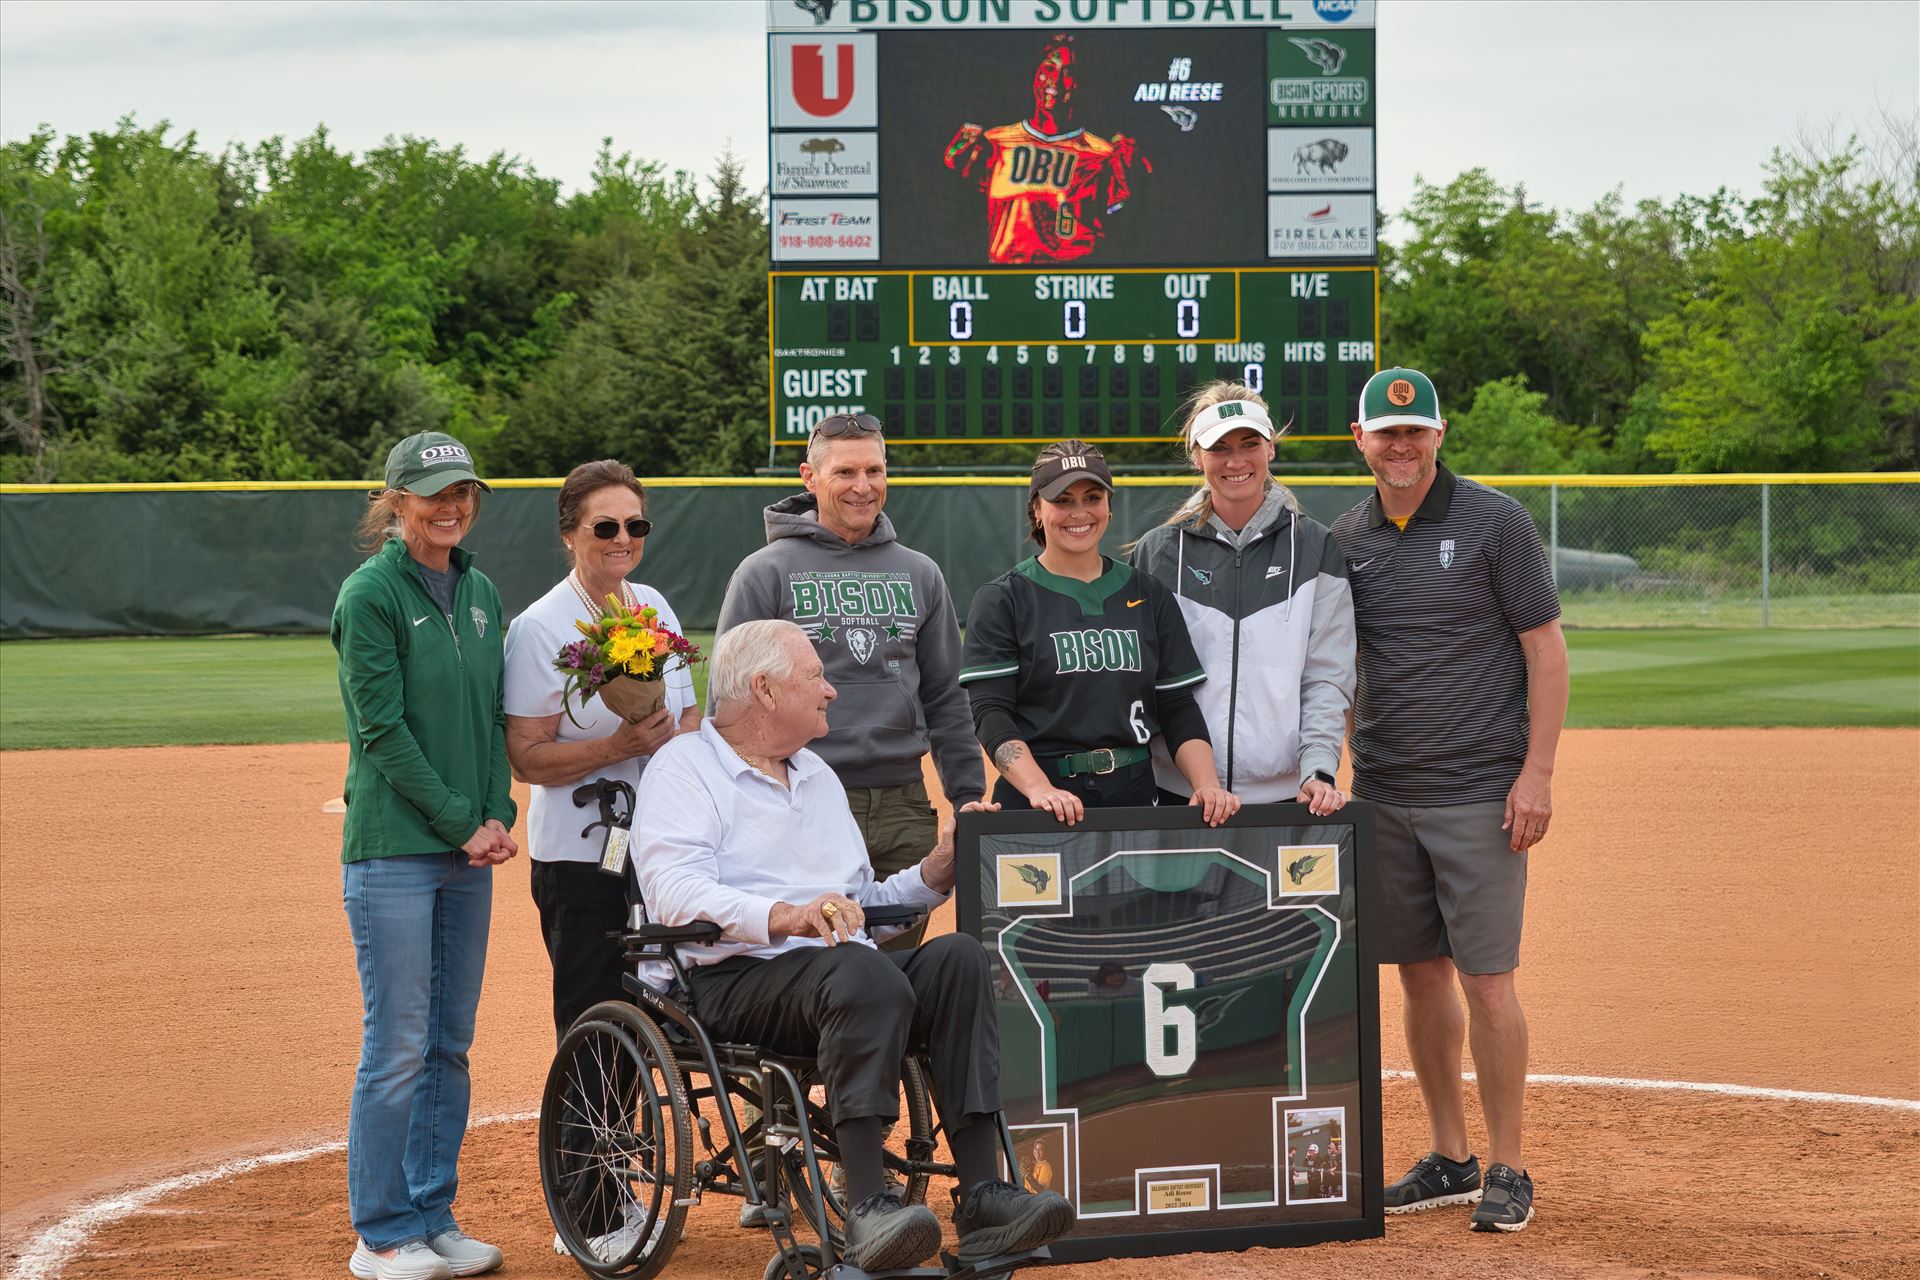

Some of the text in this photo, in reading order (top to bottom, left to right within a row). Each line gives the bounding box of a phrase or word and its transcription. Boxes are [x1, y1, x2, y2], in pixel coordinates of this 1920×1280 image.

[850, 0, 1010, 22] BISON
[1168, 57, 1192, 81] #6
[1134, 82, 1223, 102] ADI REESE
[1277, 83, 1364, 101] BISON SPORTS
[1278, 105, 1361, 118] NETWORK
[824, 161, 872, 175] Dental
[1010, 145, 1077, 188] OBU
[1057, 201, 1076, 237] 6
[1273, 227, 1369, 240] FIRELAKE
[1297, 241, 1334, 251] BREAD
[1336, 240, 1369, 250] TACO
[800, 277, 878, 301] AT BAT
[932, 276, 989, 300] BALL
[1035, 275, 1115, 300] STRIKE
[1164, 274, 1211, 298] OUT
[1290, 273, 1329, 299] H/E
[950, 301, 973, 339] 0
[1064, 300, 1086, 339] 0
[1177, 300, 1199, 338] 0
[890, 345, 1197, 365] 1 2 3 4 5 6 7 8 9 10
[1215, 341, 1375, 362] RUNS HITS ERR
[783, 369, 868, 398] GUEST
[1244, 364, 1263, 394] 0
[1393, 382, 1410, 394] OBU
[786, 404, 866, 434] HO
[1217, 402, 1244, 419] OBU
[420, 445, 466, 460] OBU
[1061, 456, 1087, 470] OBU
[1440, 540, 1455, 551] OBU
[791, 580, 917, 618] BISON
[841, 617, 880, 626] SOFTBALL
[1050, 628, 1142, 675] BISON
[1130, 700, 1150, 744] 6
[1143, 962, 1196, 1078] 6
[1175, 1189, 1192, 1197] Reese
